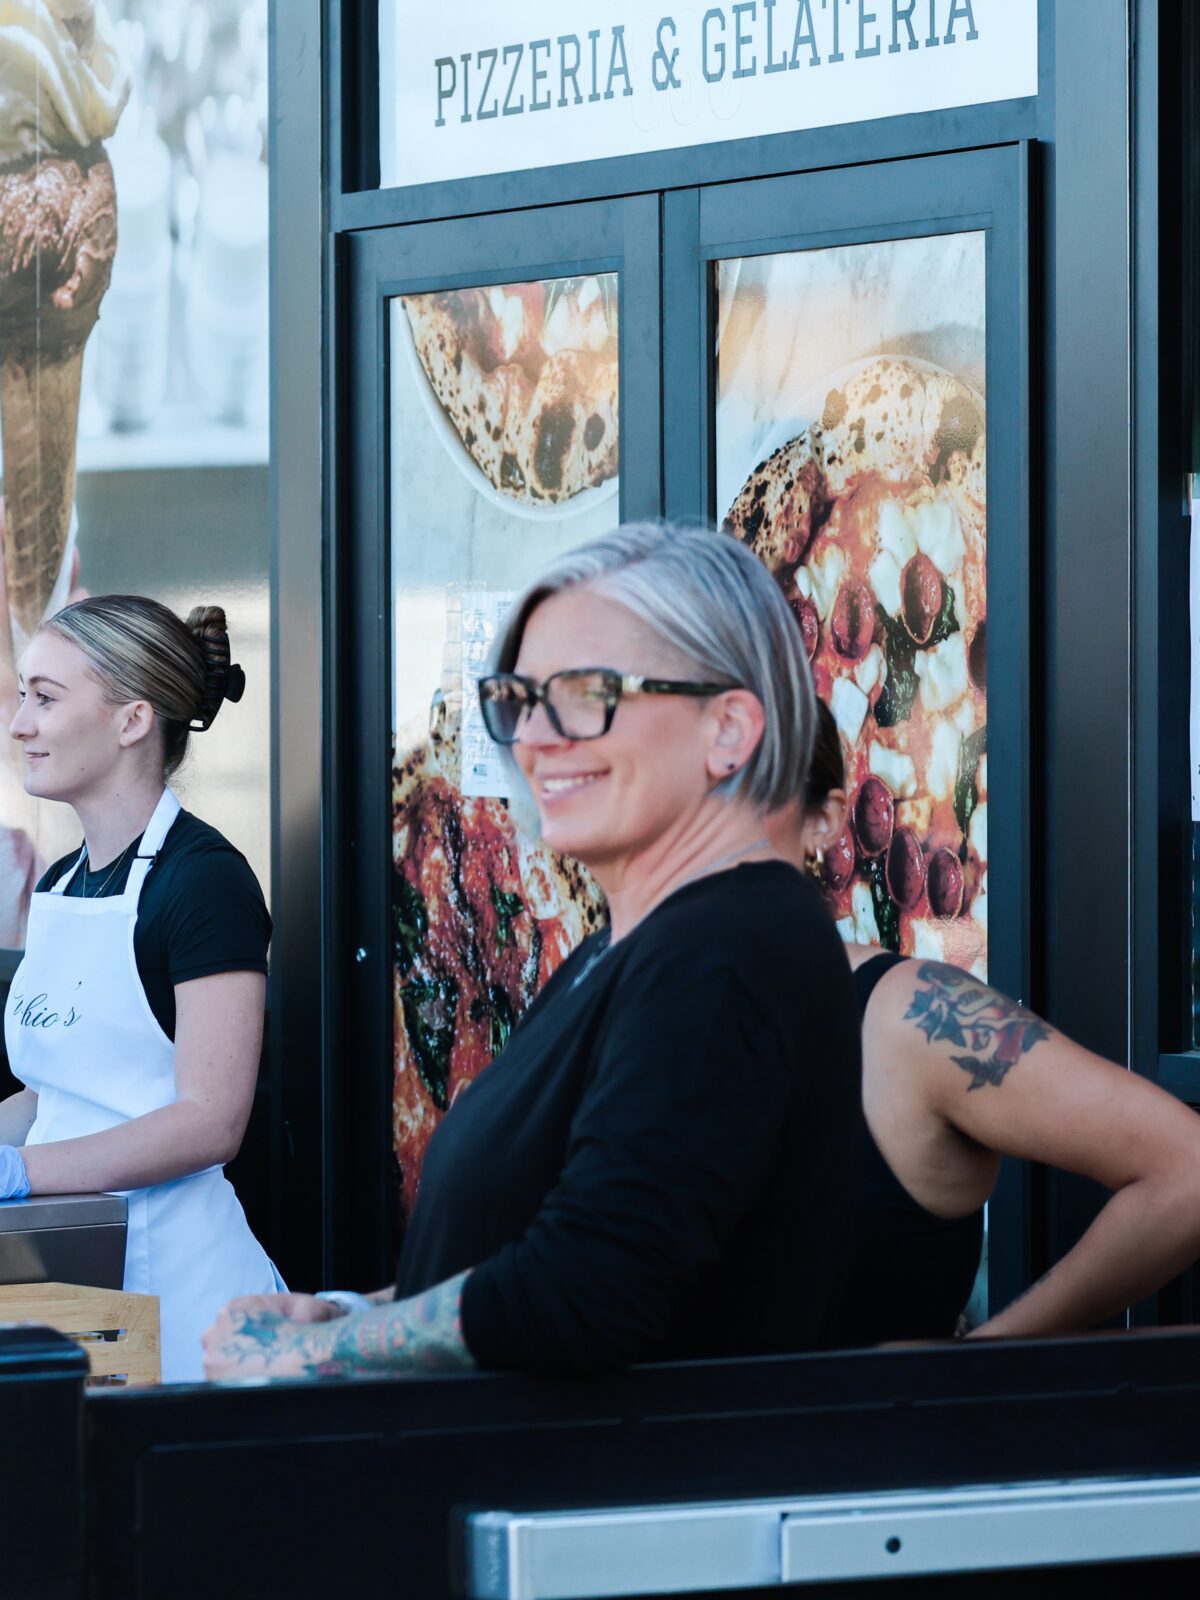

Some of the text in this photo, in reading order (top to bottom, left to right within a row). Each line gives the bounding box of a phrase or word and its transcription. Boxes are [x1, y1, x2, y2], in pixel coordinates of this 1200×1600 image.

[434, 0, 979, 127] PIZZERIA & GELATERIA
